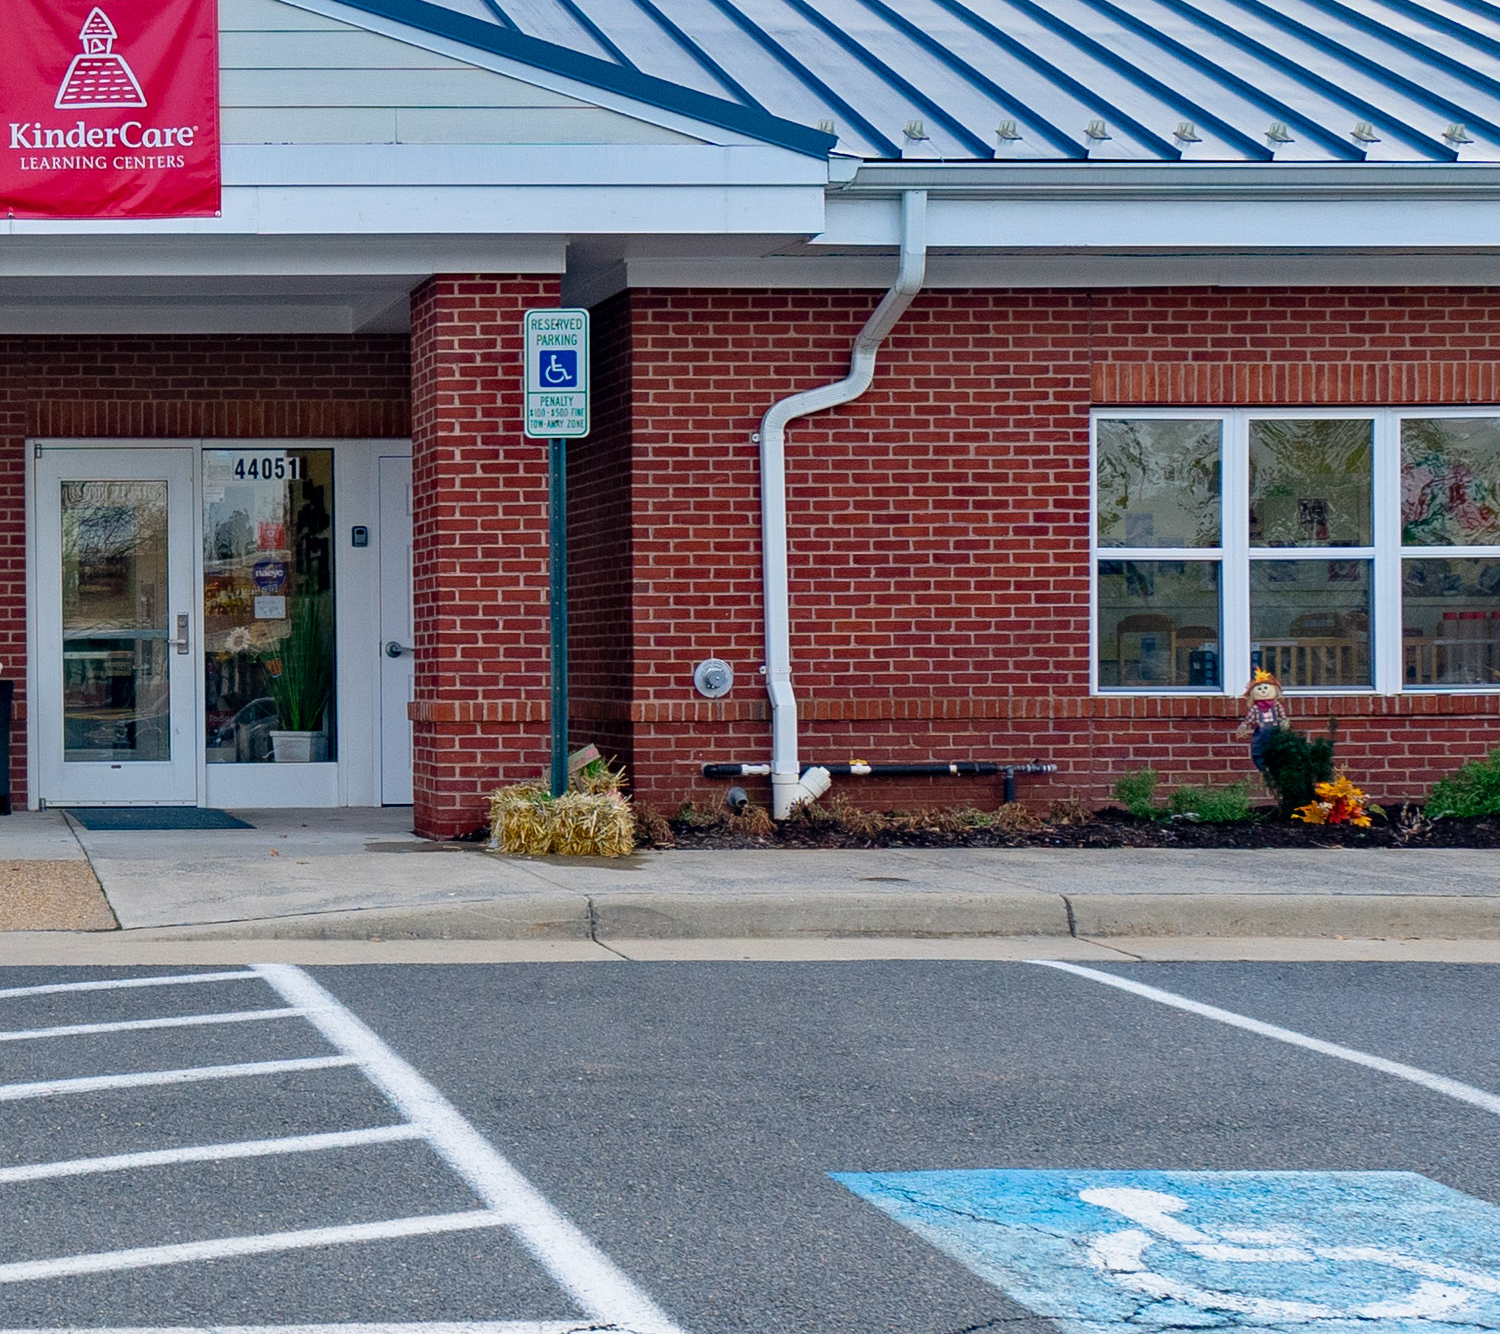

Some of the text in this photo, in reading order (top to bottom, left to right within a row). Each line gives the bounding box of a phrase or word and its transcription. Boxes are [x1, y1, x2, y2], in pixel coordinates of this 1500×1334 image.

[9, 121, 195, 149] KinderCare
[20, 155, 185, 170] LEARNING CENTERS
[531, 318, 583, 330] RESERVED
[536, 334, 578, 346] PARKING
[540, 396, 574, 406] PENALTY
[571, 408, 585, 417] FINE
[530, 419, 585, 428] TOW-AWAY ZONE
[234, 457, 297, 480] 44051
